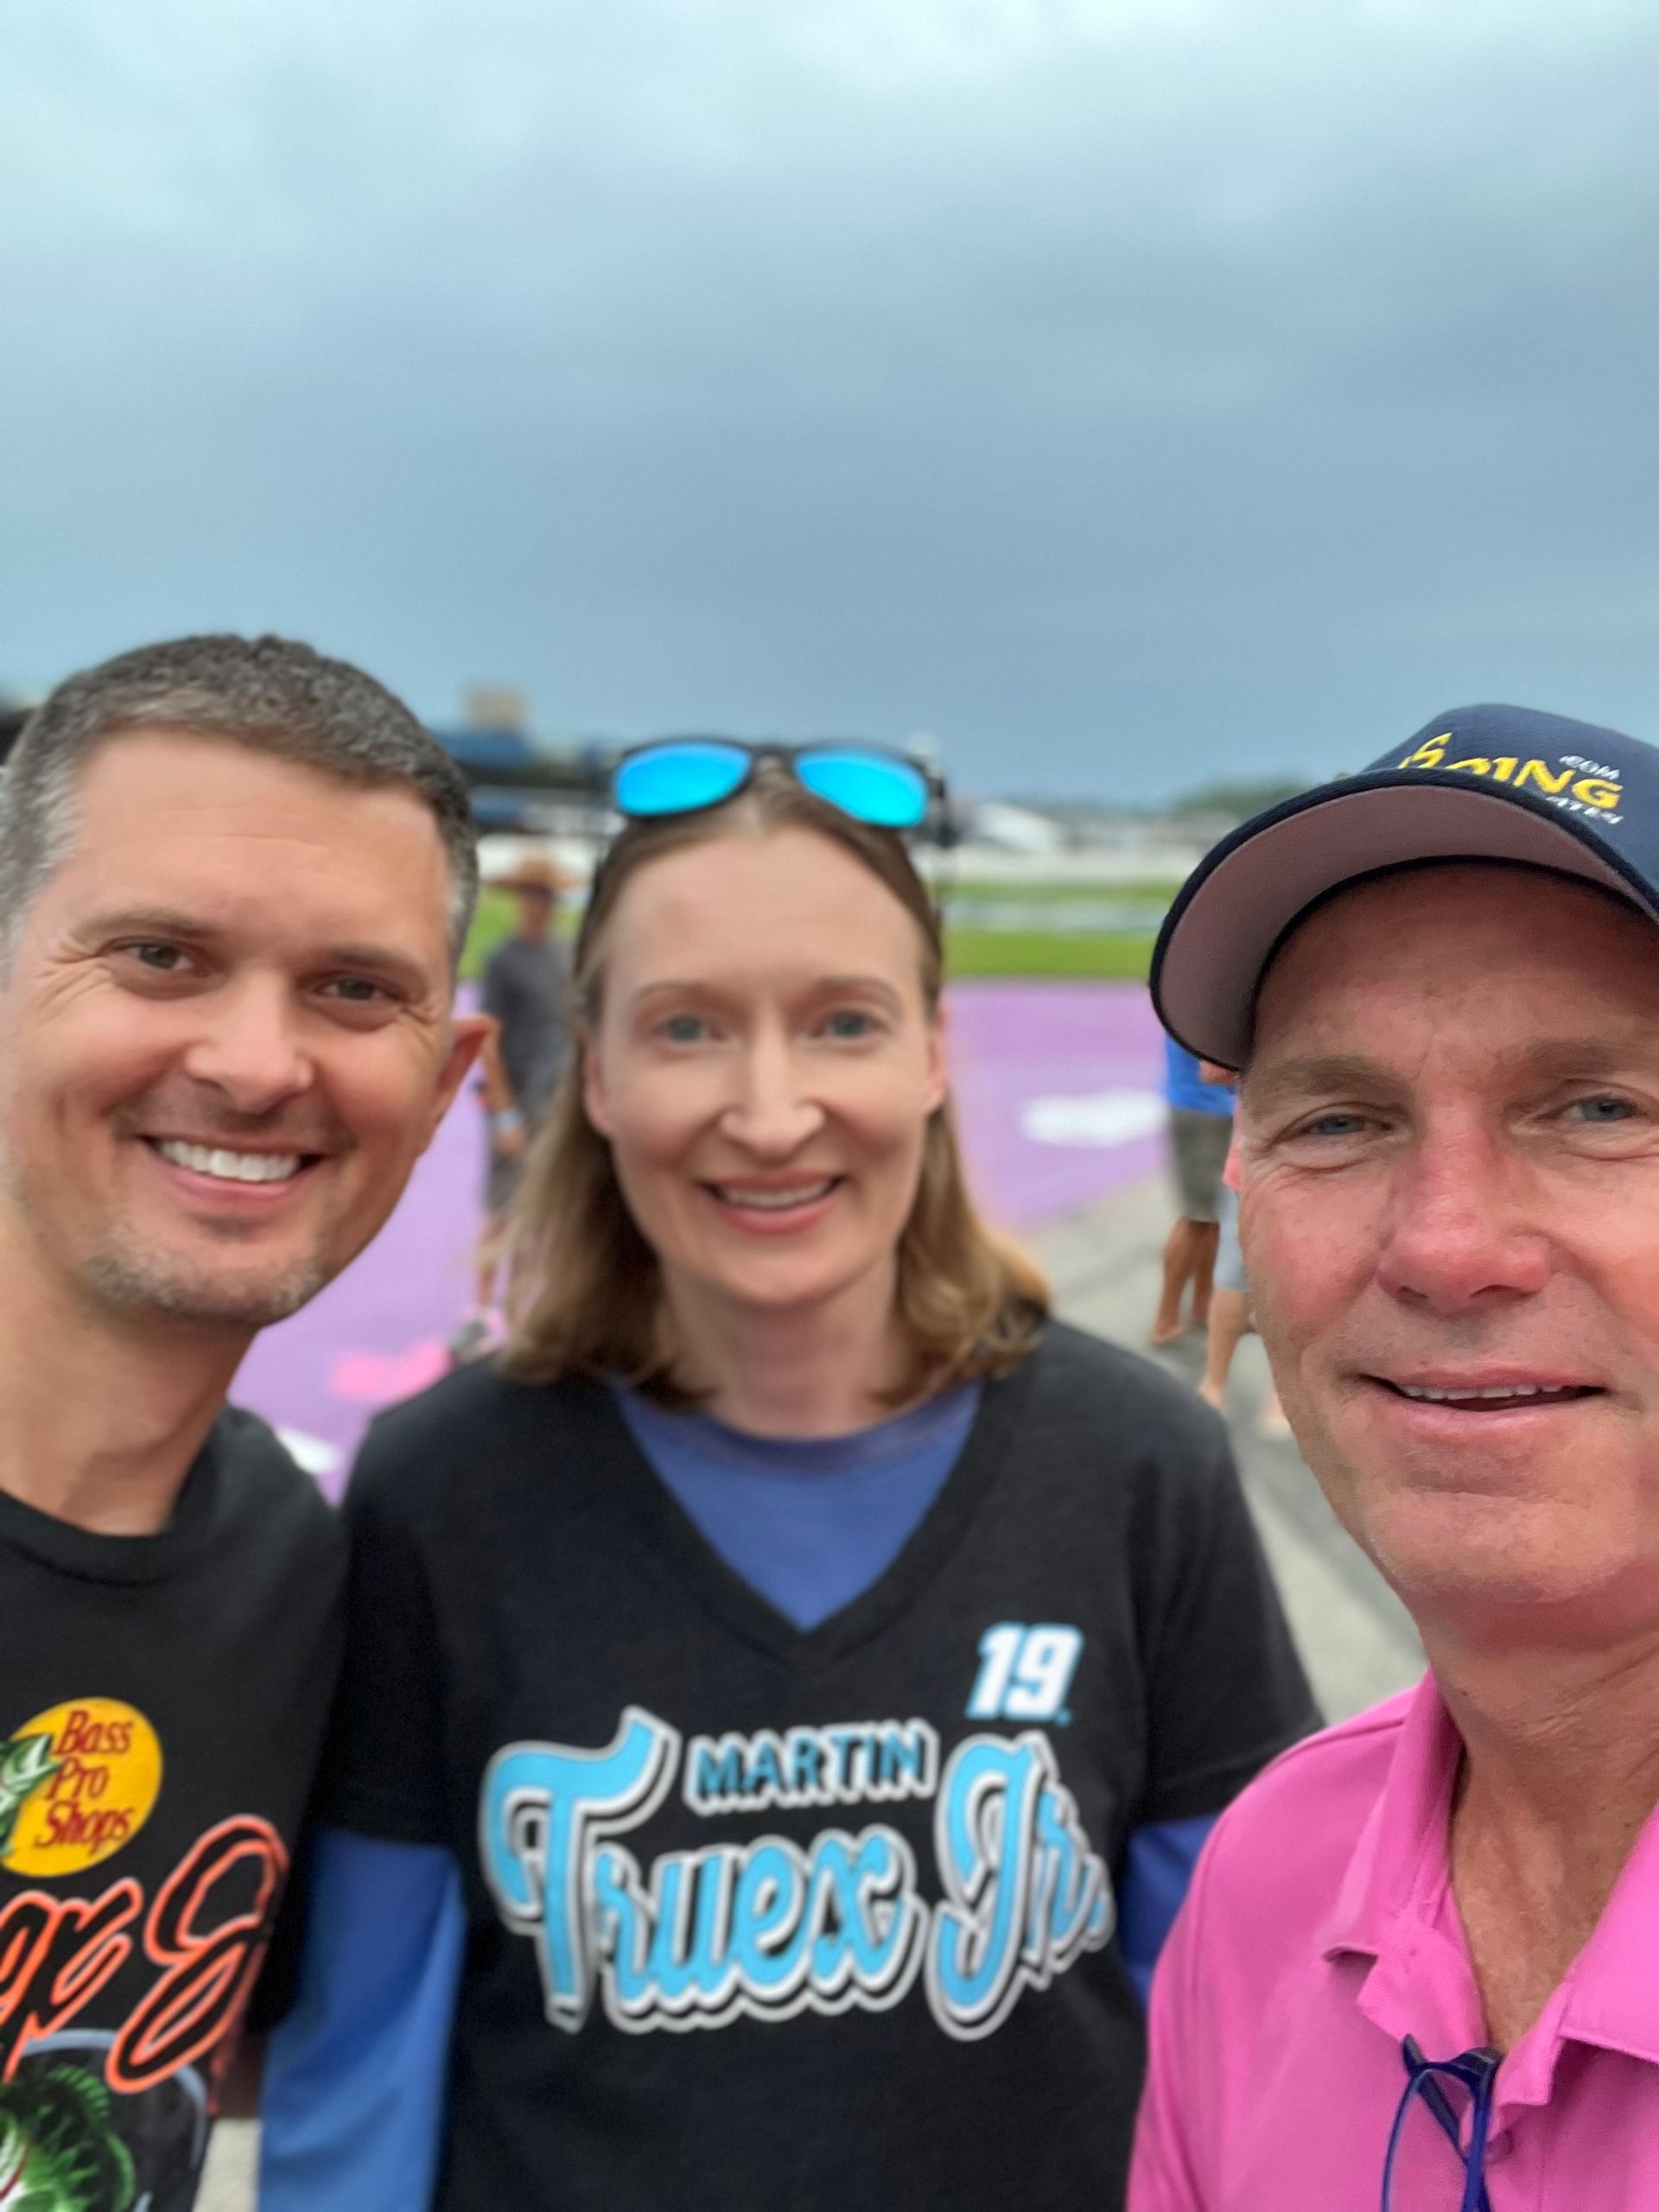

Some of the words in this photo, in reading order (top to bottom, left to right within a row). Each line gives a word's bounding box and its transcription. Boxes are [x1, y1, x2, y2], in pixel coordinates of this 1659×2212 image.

[965, 1620, 1085, 1721] 19
[53, 1709, 134, 1755] Bass
[684, 1719, 939, 1815] MARTIN
[46, 1757, 108, 1800] Pro
[34, 1800, 135, 1856] Shops
[478, 1703, 930, 2034] Truex
